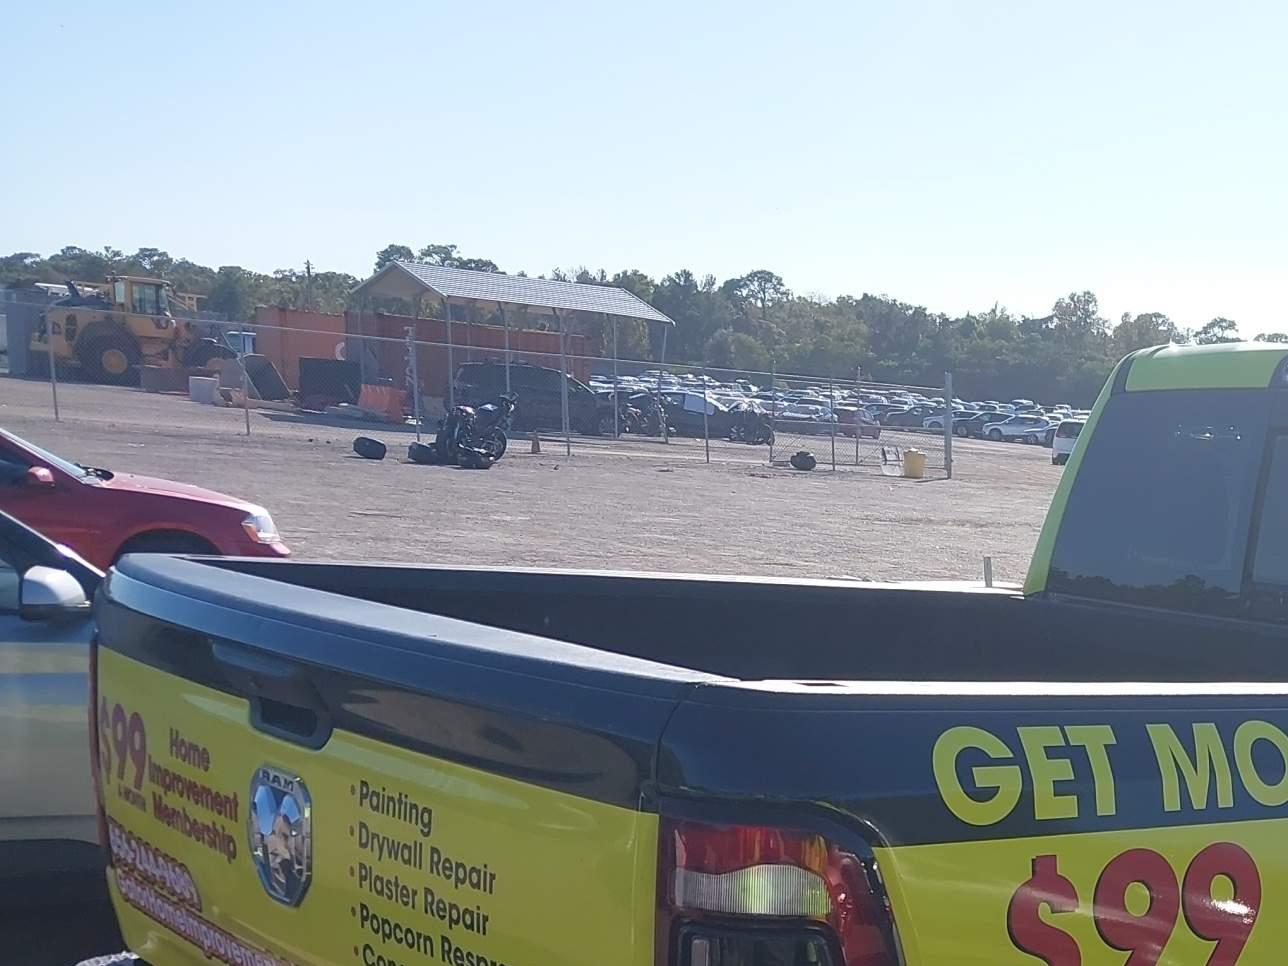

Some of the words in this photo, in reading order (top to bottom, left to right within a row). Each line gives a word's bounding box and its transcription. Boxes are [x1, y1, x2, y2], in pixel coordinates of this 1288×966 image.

[101, 696, 146, 791] $99
[169, 726, 210, 772] Home
[932, 725, 1118, 826] GET
[148, 753, 239, 822] Improvement
[261, 767, 295, 792] RAM
[360, 780, 432, 837] Painting
[152, 791, 237, 864] Membership
[358, 821, 422, 870] Drywall
[430, 846, 496, 895] Repair
[358, 863, 418, 910] Plaster
[424, 887, 489, 935] Repair
[359, 903, 434, 958] Popcorn
